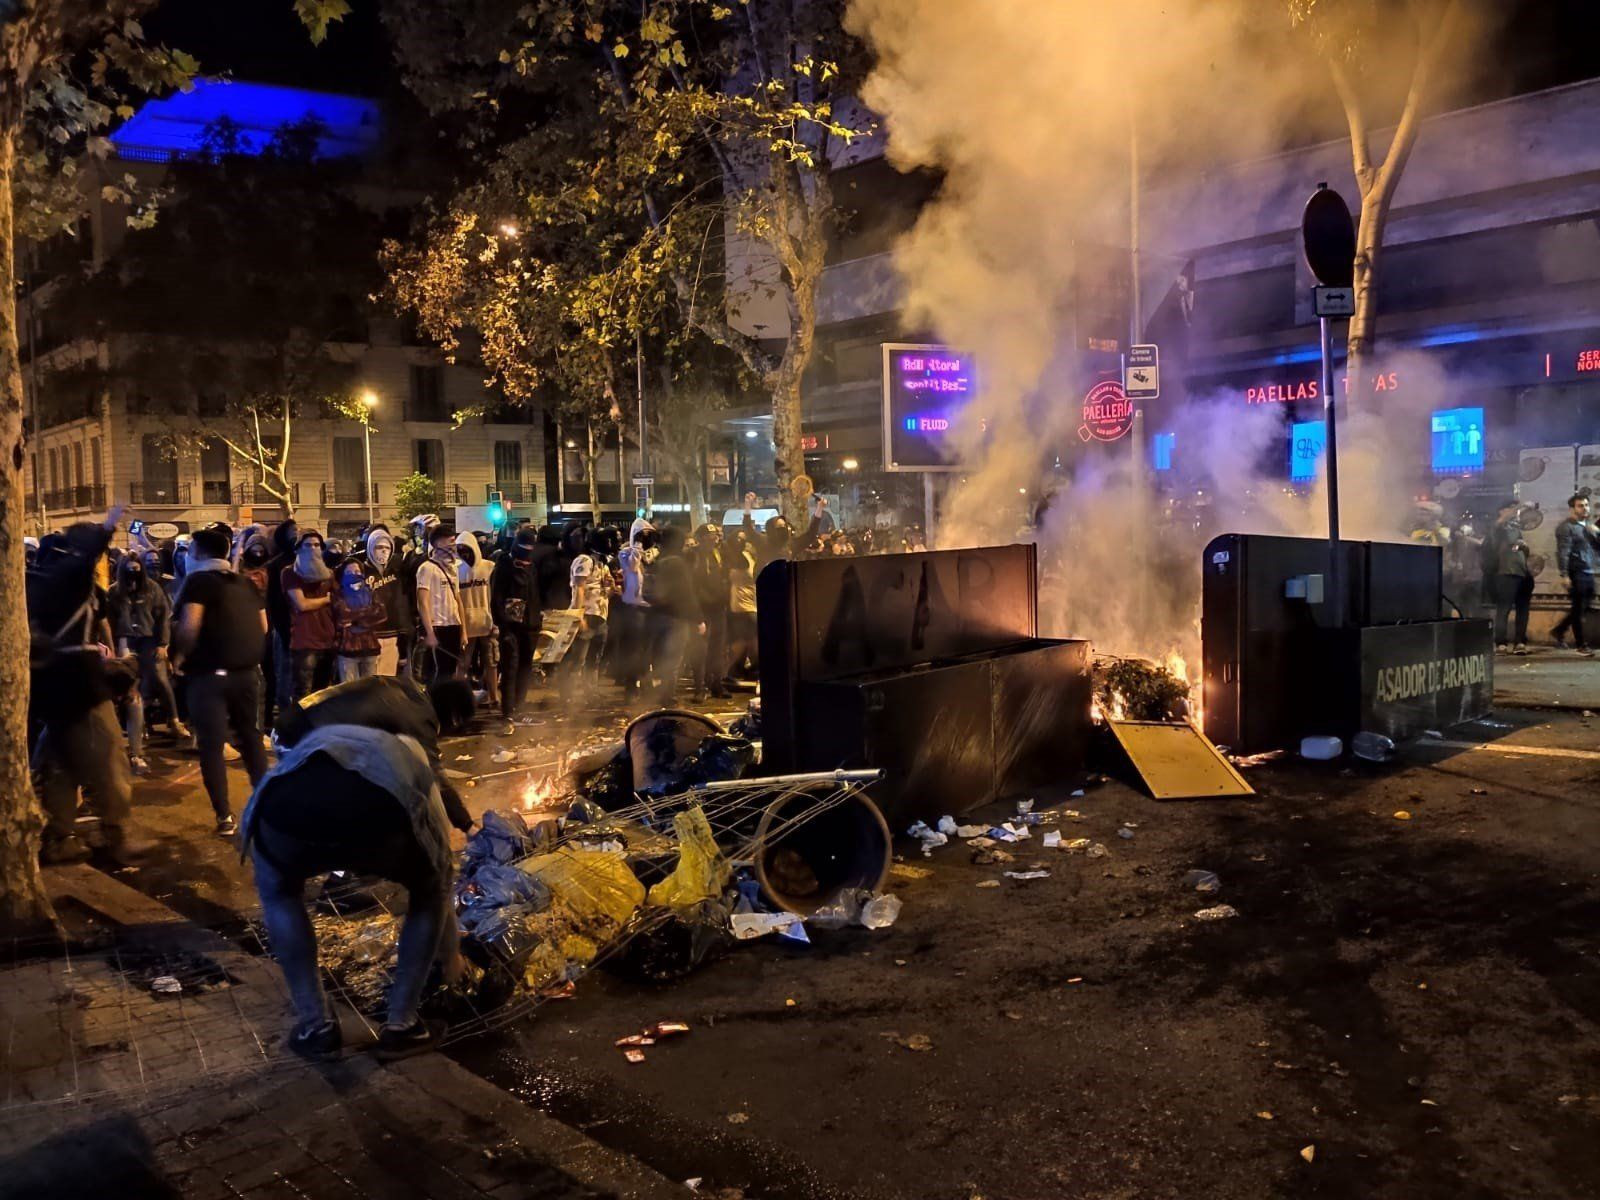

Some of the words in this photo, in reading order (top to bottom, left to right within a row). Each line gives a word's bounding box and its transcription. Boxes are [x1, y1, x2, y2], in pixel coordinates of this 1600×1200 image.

[1247, 381, 1319, 405] PAELLAS
[921, 419, 949, 431] FLUID
[1376, 663, 1427, 702] ASADOR
[1428, 661, 1441, 693] DE
[1442, 654, 1486, 690] ARANDA
